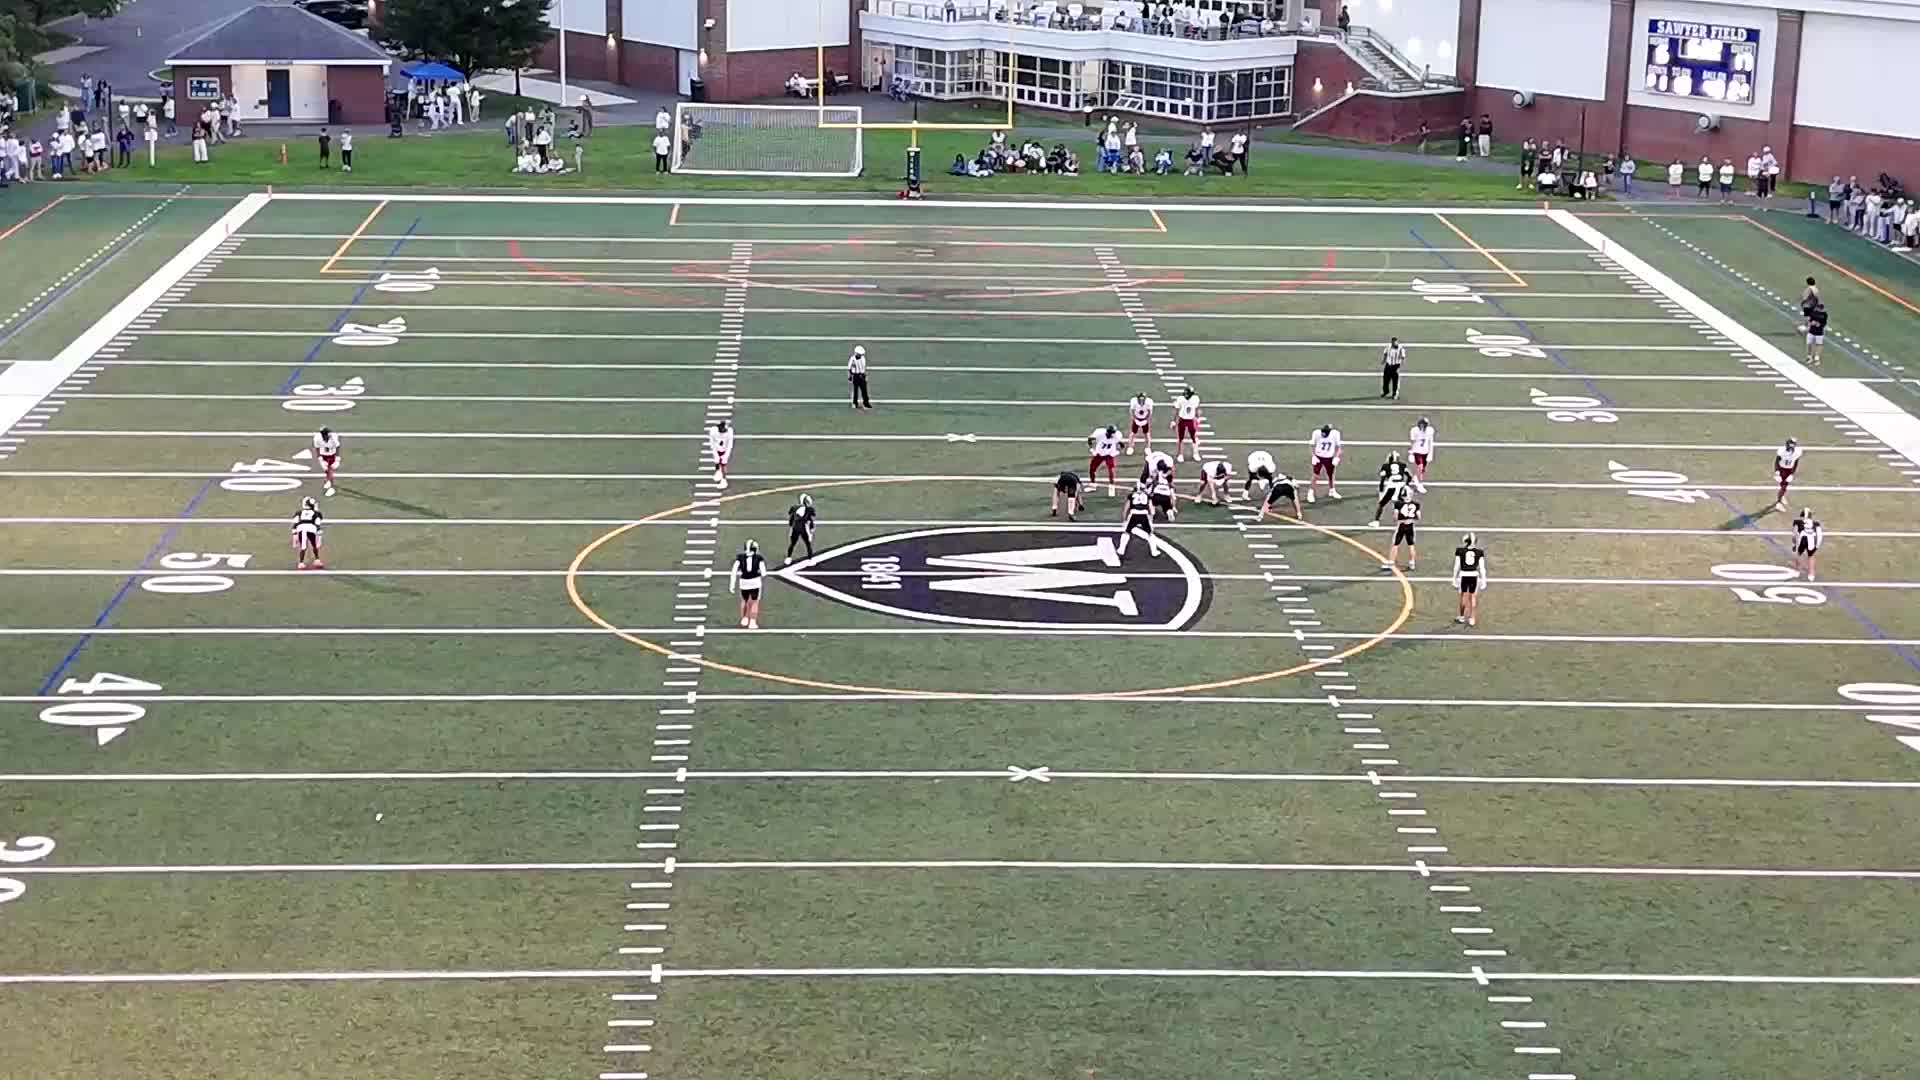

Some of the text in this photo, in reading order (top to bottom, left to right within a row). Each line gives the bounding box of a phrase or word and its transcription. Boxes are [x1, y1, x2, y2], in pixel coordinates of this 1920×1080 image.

[1657, 21, 1748, 42] SAWYER FIELD
[374, 273, 440, 292] 10
[1411, 284, 1484, 303] 10
[332, 324, 407, 346] 20
[1466, 335, 1547, 358] 20
[281, 384, 365, 411] 30
[1531, 396, 1619, 422] 30
[220, 459, 311, 491] 40
[1611, 470, 1711, 503] 40
[1401, 503, 1417, 518] 42
[141, 552, 252, 593] 50
[926, 537, 1139, 616] W
[1711, 563, 1827, 604] 50
[39, 672, 162, 726] 40
